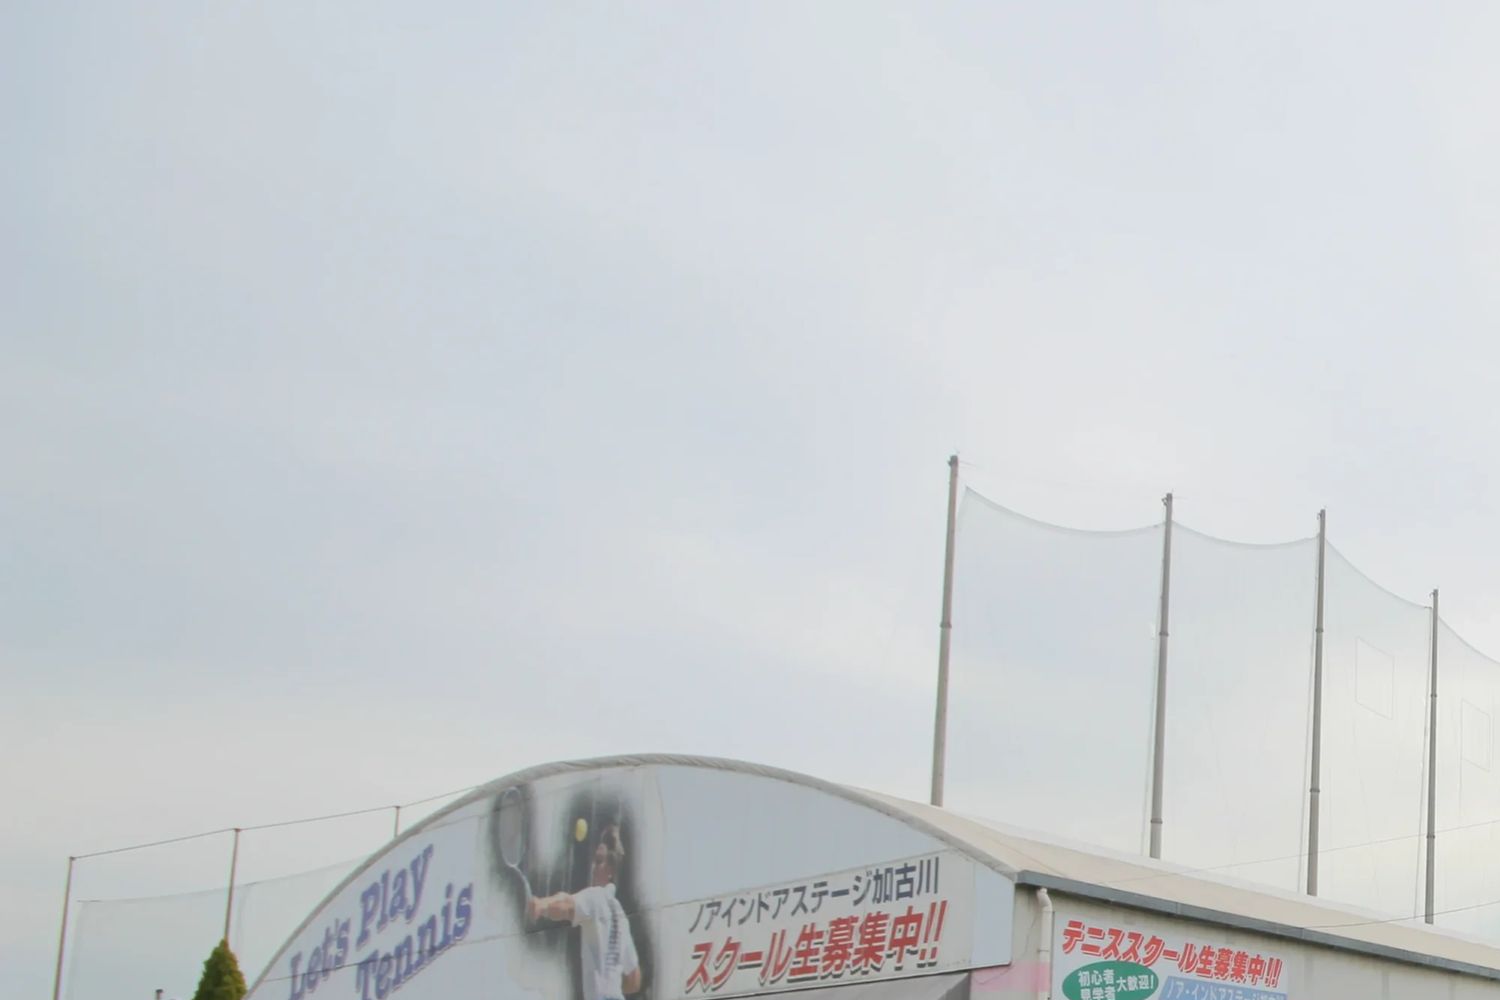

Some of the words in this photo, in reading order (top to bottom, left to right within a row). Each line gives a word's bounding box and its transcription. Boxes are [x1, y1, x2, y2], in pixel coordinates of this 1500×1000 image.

[356, 844, 433, 951] Play
[688, 856, 940, 933] ノアインドアステージ加古川
[685, 900, 948, 993] スクール生募集中!!
[1062, 920, 1283, 988] テニススクール生募集中!!
